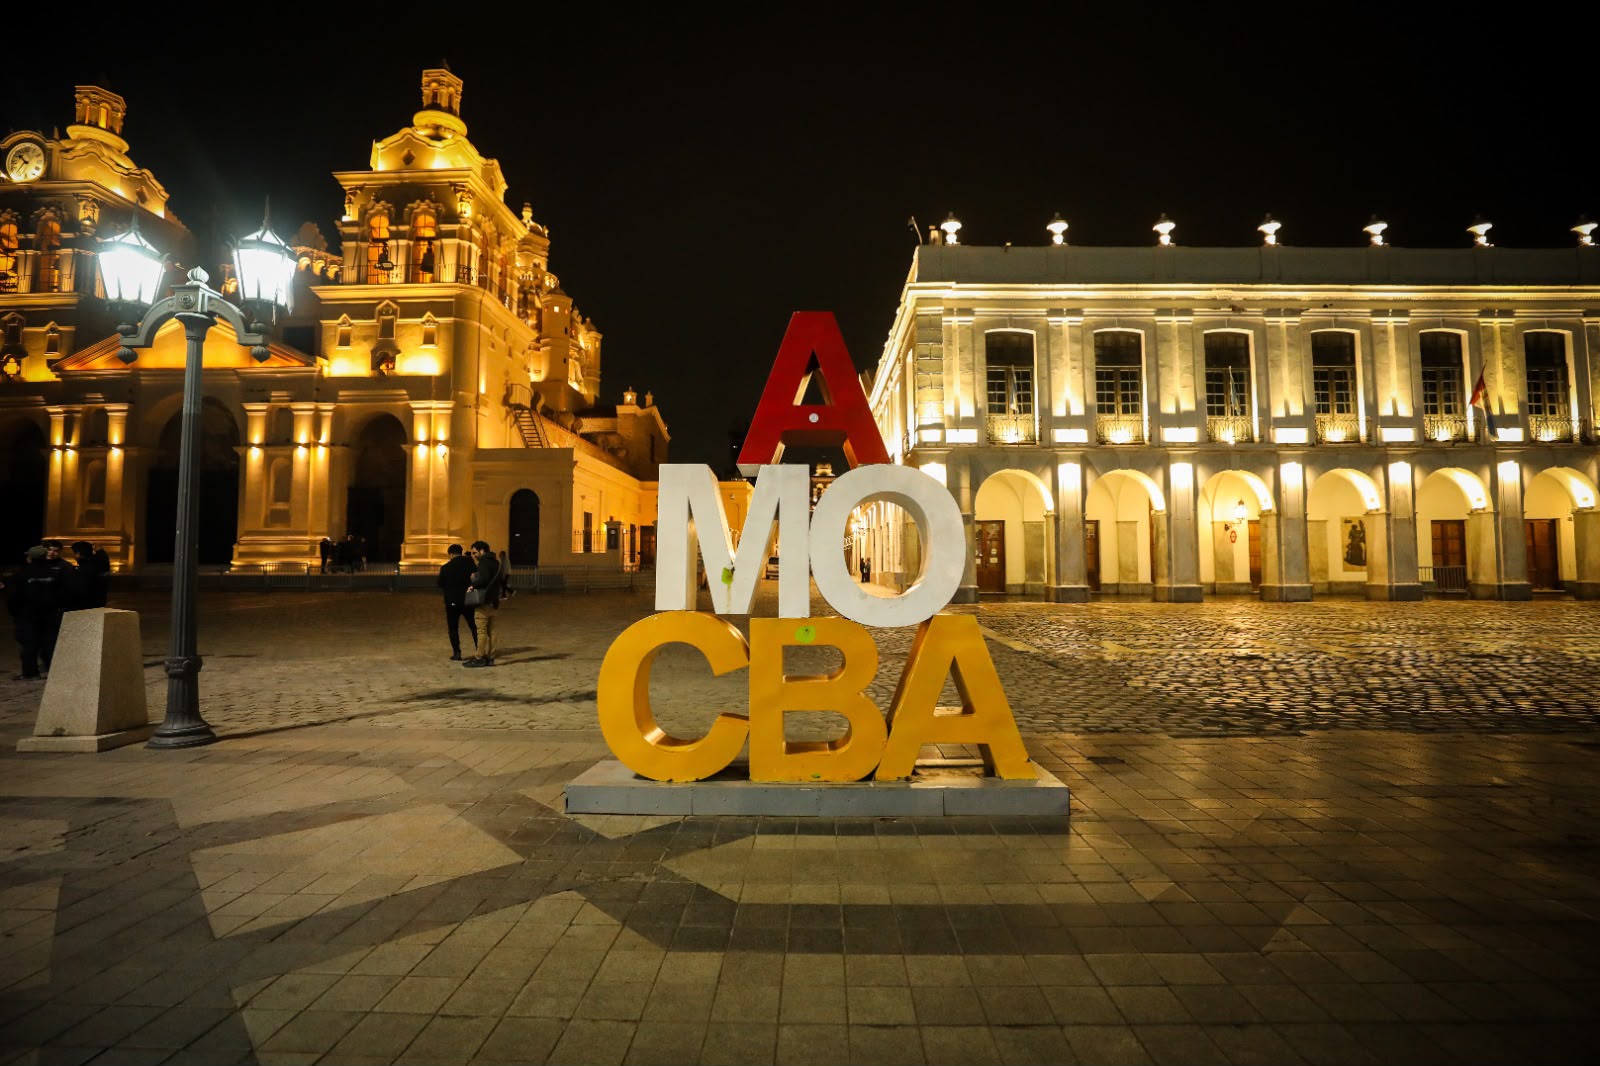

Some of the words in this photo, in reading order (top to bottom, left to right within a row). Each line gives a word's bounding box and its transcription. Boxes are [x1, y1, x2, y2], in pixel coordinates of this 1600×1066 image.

[737, 311, 890, 465] A
[655, 464, 966, 628] MO
[597, 610, 1038, 782] CBA
